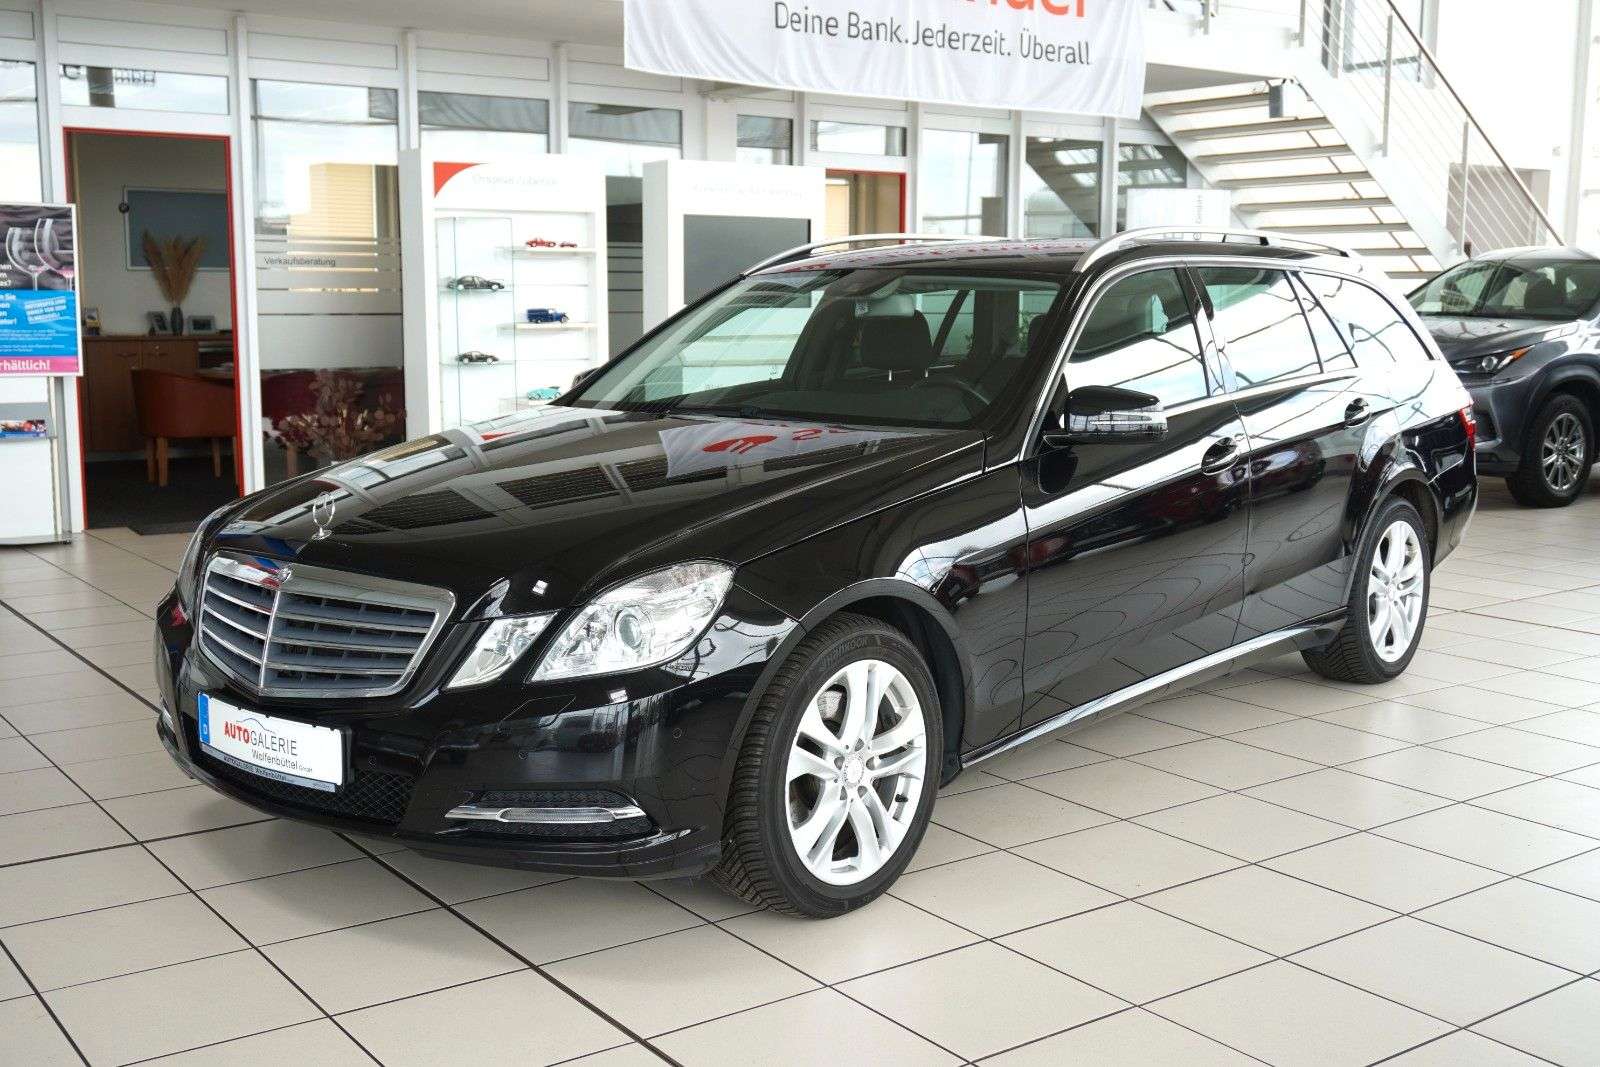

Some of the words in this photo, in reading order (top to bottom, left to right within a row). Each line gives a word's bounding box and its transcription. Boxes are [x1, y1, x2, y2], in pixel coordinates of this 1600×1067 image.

[774, 1, 839, 38] Deine
[1020, 28, 1091, 66] Überall
[264, 256, 336, 267] Verkaufsberatung
[224, 721, 298, 756] AUTOGALERIE
[252, 749, 298, 770] Wolfenbüttel
